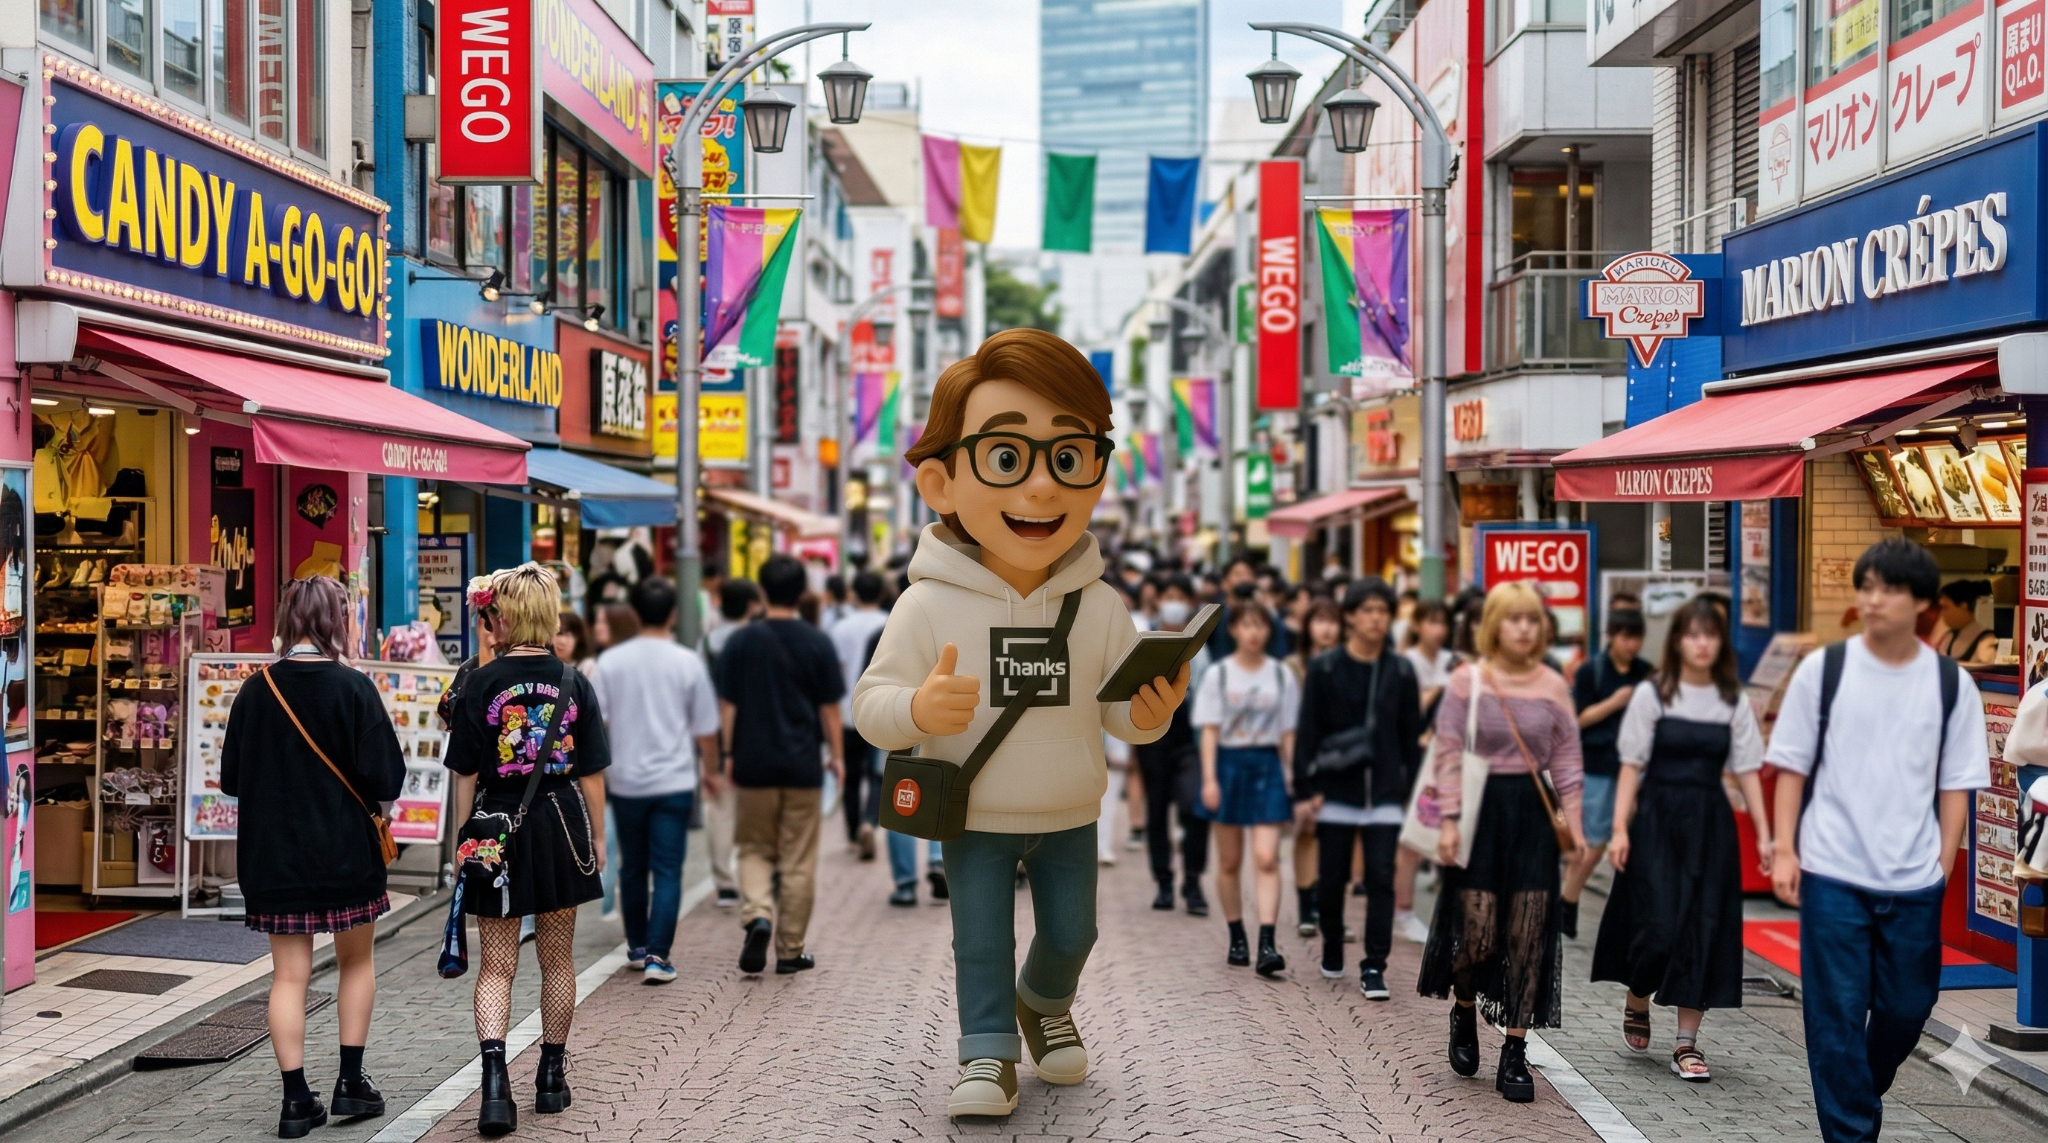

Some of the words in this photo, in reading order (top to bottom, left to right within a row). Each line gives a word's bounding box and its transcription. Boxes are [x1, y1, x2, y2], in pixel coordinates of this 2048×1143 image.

[460, 7, 511, 143] WEGO
[1807, 91, 1878, 165] マリオン
[1891, 31, 1982, 134] クレープ
[70, 123, 236, 277] CANDY
[244, 191, 384, 321] A-GO-GO!
[1740, 237, 1858, 328] MARION
[1862, 194, 2007, 300] CRÉPES
[1261, 236, 1297, 334] WEGO
[1601, 286, 1695, 306] MARION
[1618, 306, 1680, 331] Crepes
[437, 320, 562, 408] WONDERLAND
[1614, 469, 1662, 496] MARION
[1663, 466, 1712, 495] CREPES
[1494, 540, 1579, 574] WEGO
[996, 657, 1067, 677] Thanks
